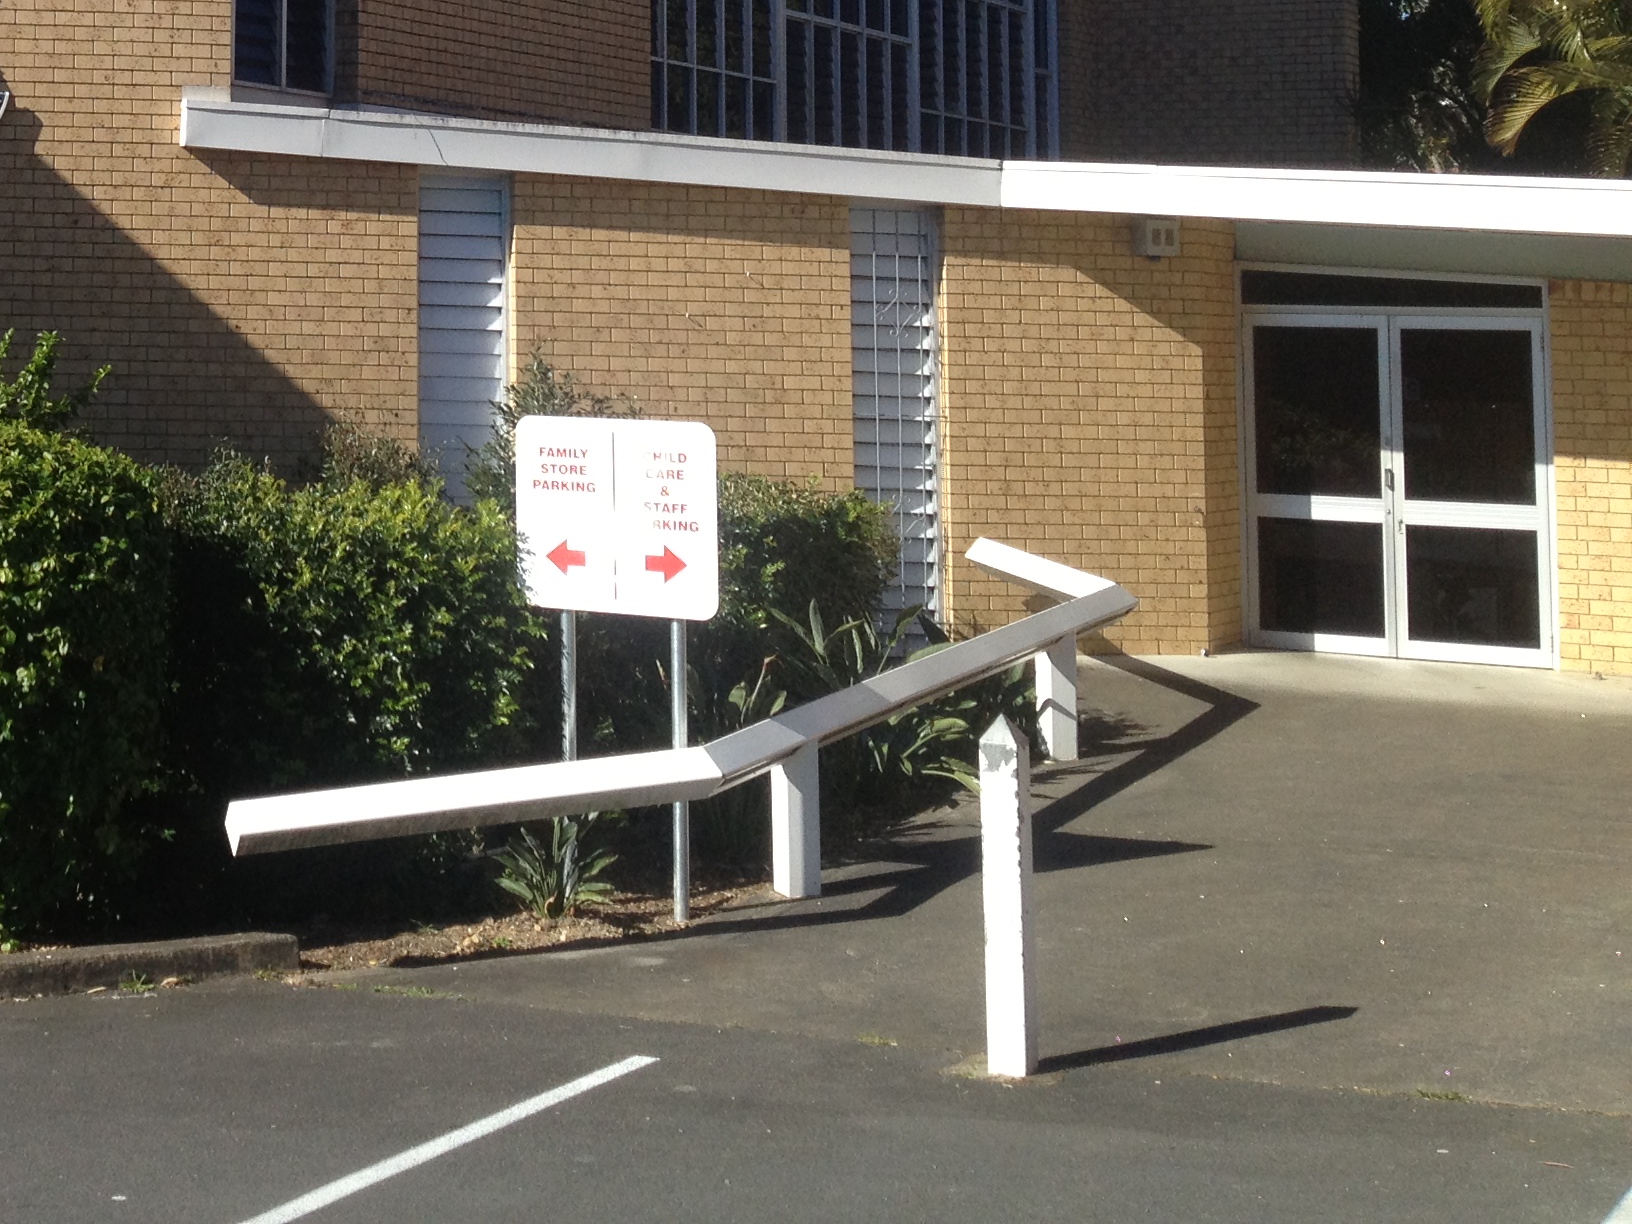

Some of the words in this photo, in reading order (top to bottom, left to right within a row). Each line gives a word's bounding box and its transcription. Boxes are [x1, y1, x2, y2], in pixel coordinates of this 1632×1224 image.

[539, 446, 588, 459] FAMILY
[541, 463, 588, 476] STORE
[645, 467, 685, 481] CARE
[532, 479, 596, 493] PARKING
[660, 485, 670, 497] &
[643, 501, 688, 515] STAFF
[652, 519, 700, 533] RKING
